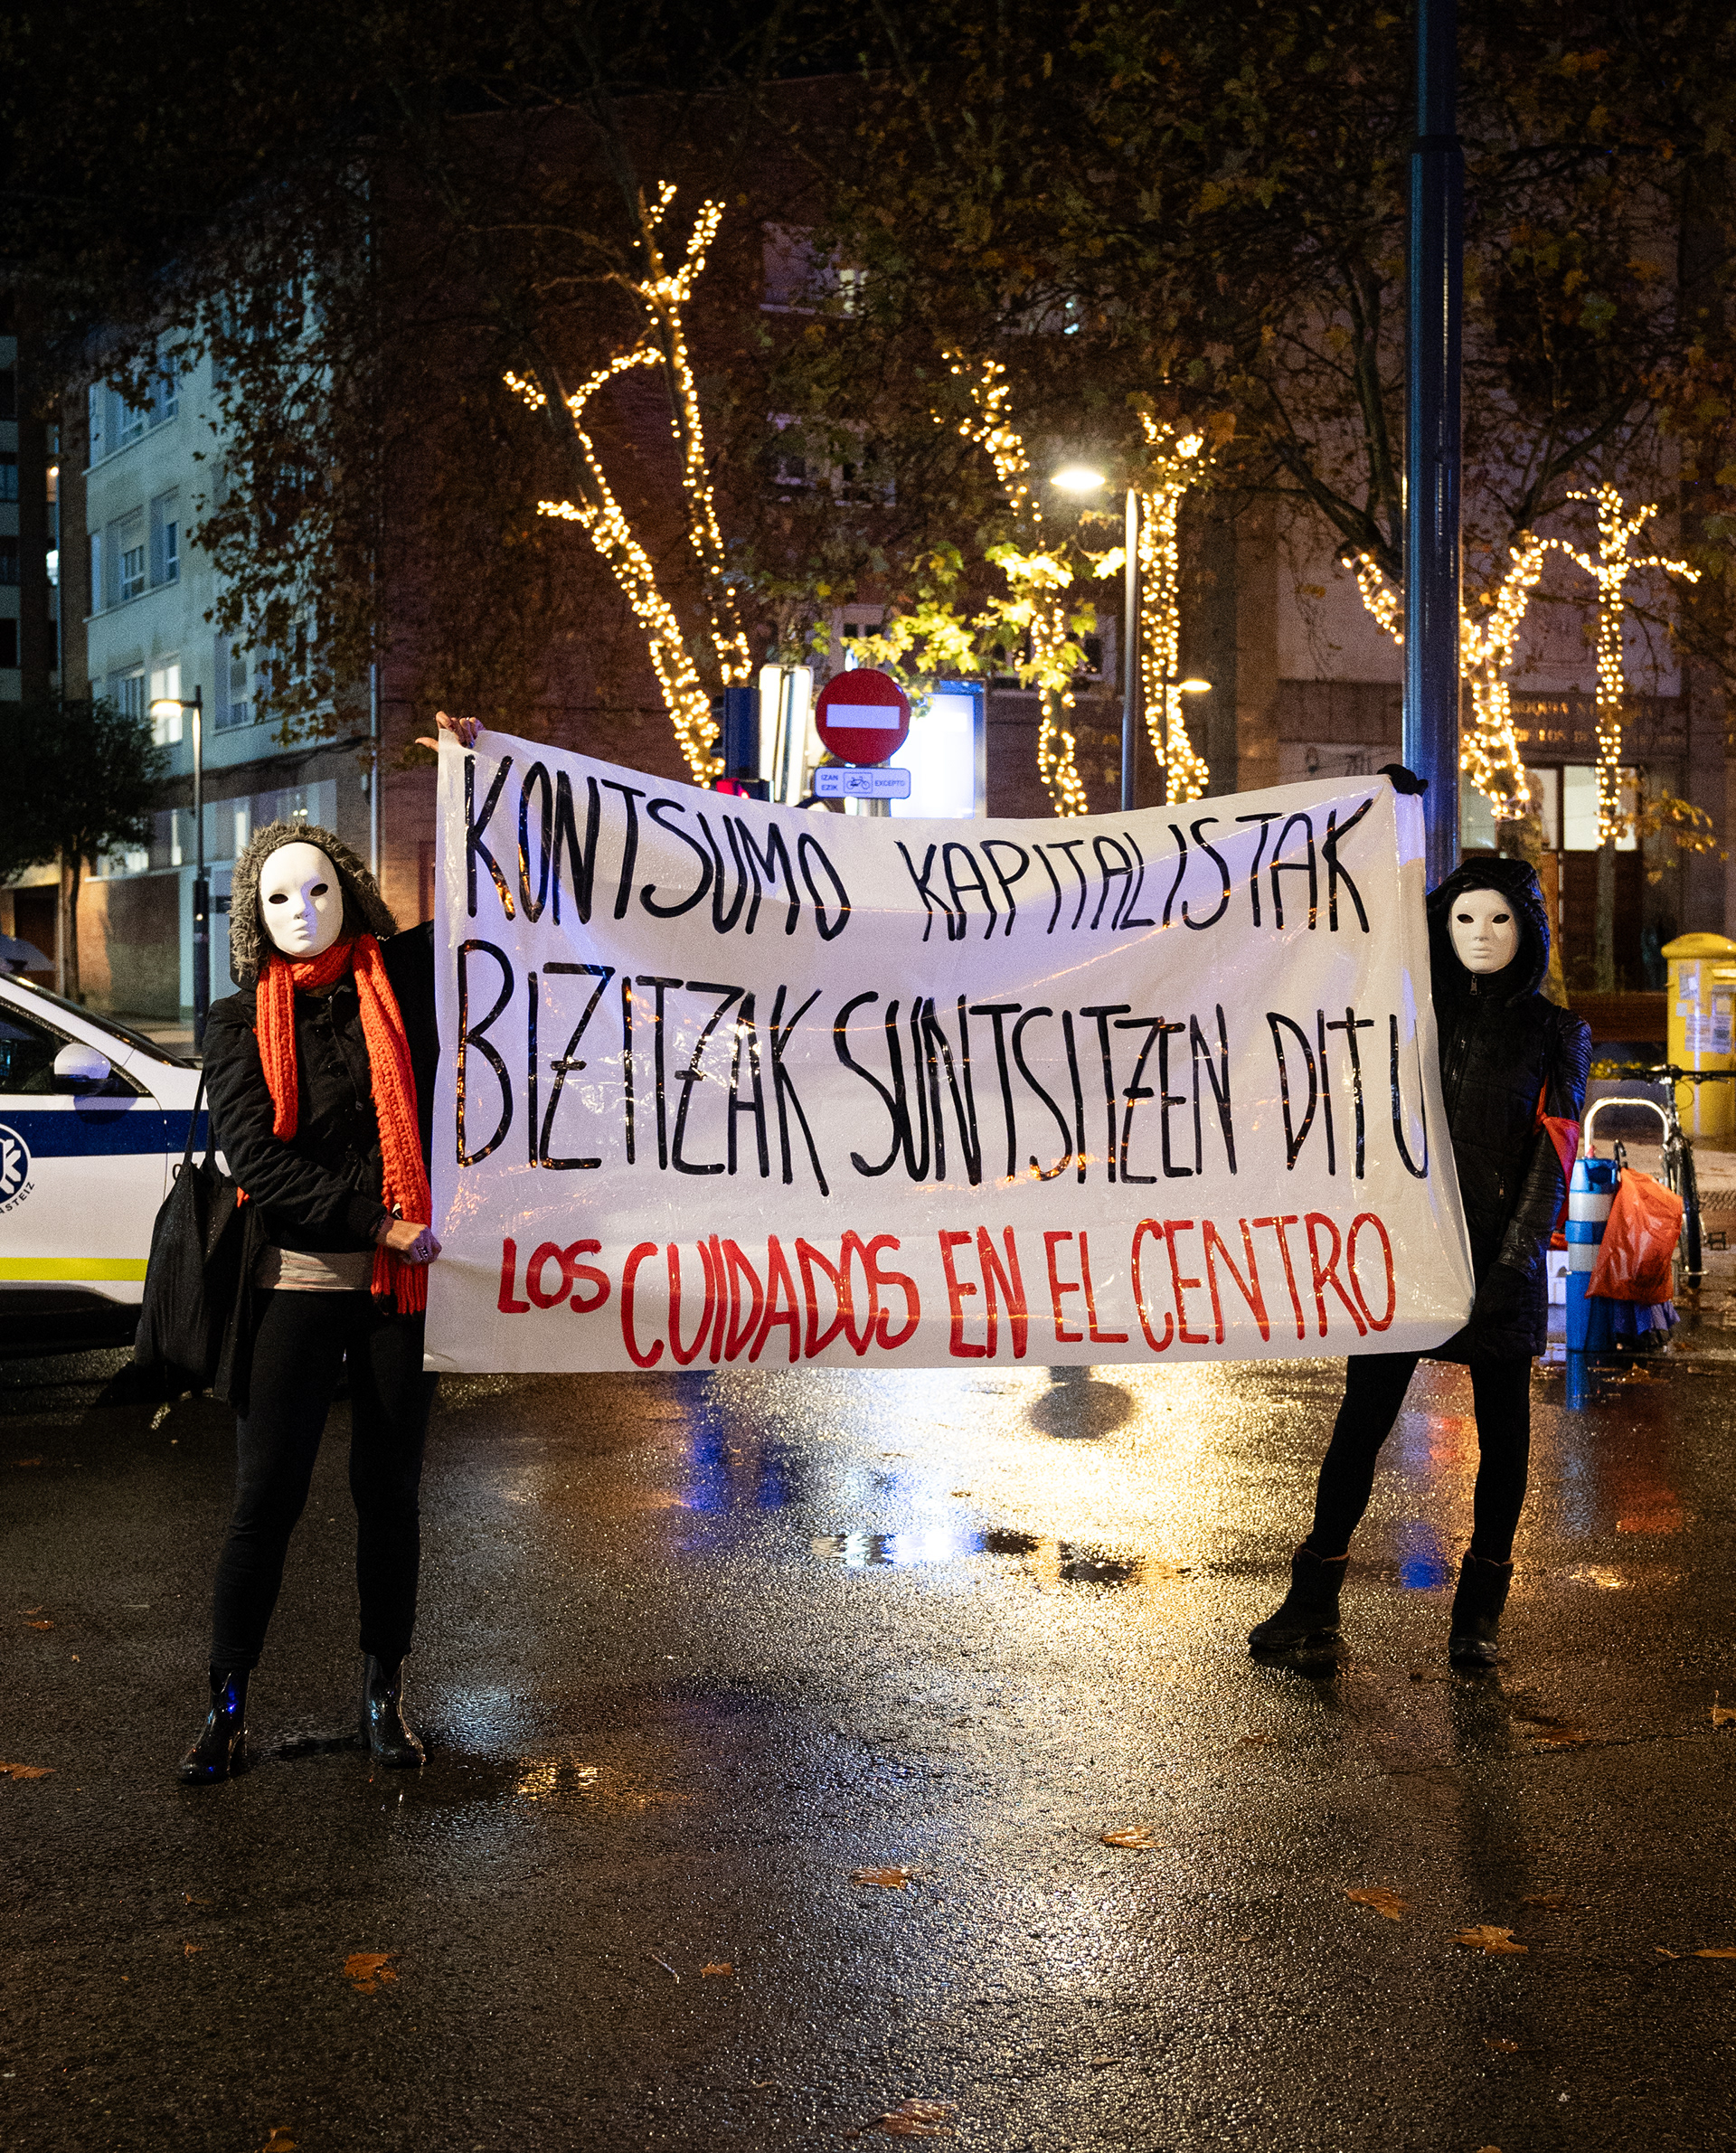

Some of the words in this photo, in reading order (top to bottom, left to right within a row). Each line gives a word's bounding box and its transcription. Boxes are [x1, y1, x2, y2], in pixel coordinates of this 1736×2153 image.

[464, 754, 852, 941] KONTSUMO
[894, 798, 1374, 941] KAPITALISTAK
[457, 939, 831, 1197] BIZITZAK
[832, 991, 1237, 1186] SUNTSITZEN
[1266, 1006, 1429, 1180] DITU
[497, 1237, 611, 1314] LOS
[620, 1229, 920, 1368] CUIDADOS
[939, 1225, 1027, 1359] EN
[1043, 1230, 1128, 1343] EL
[1130, 1212, 1395, 1352] CENTRO
